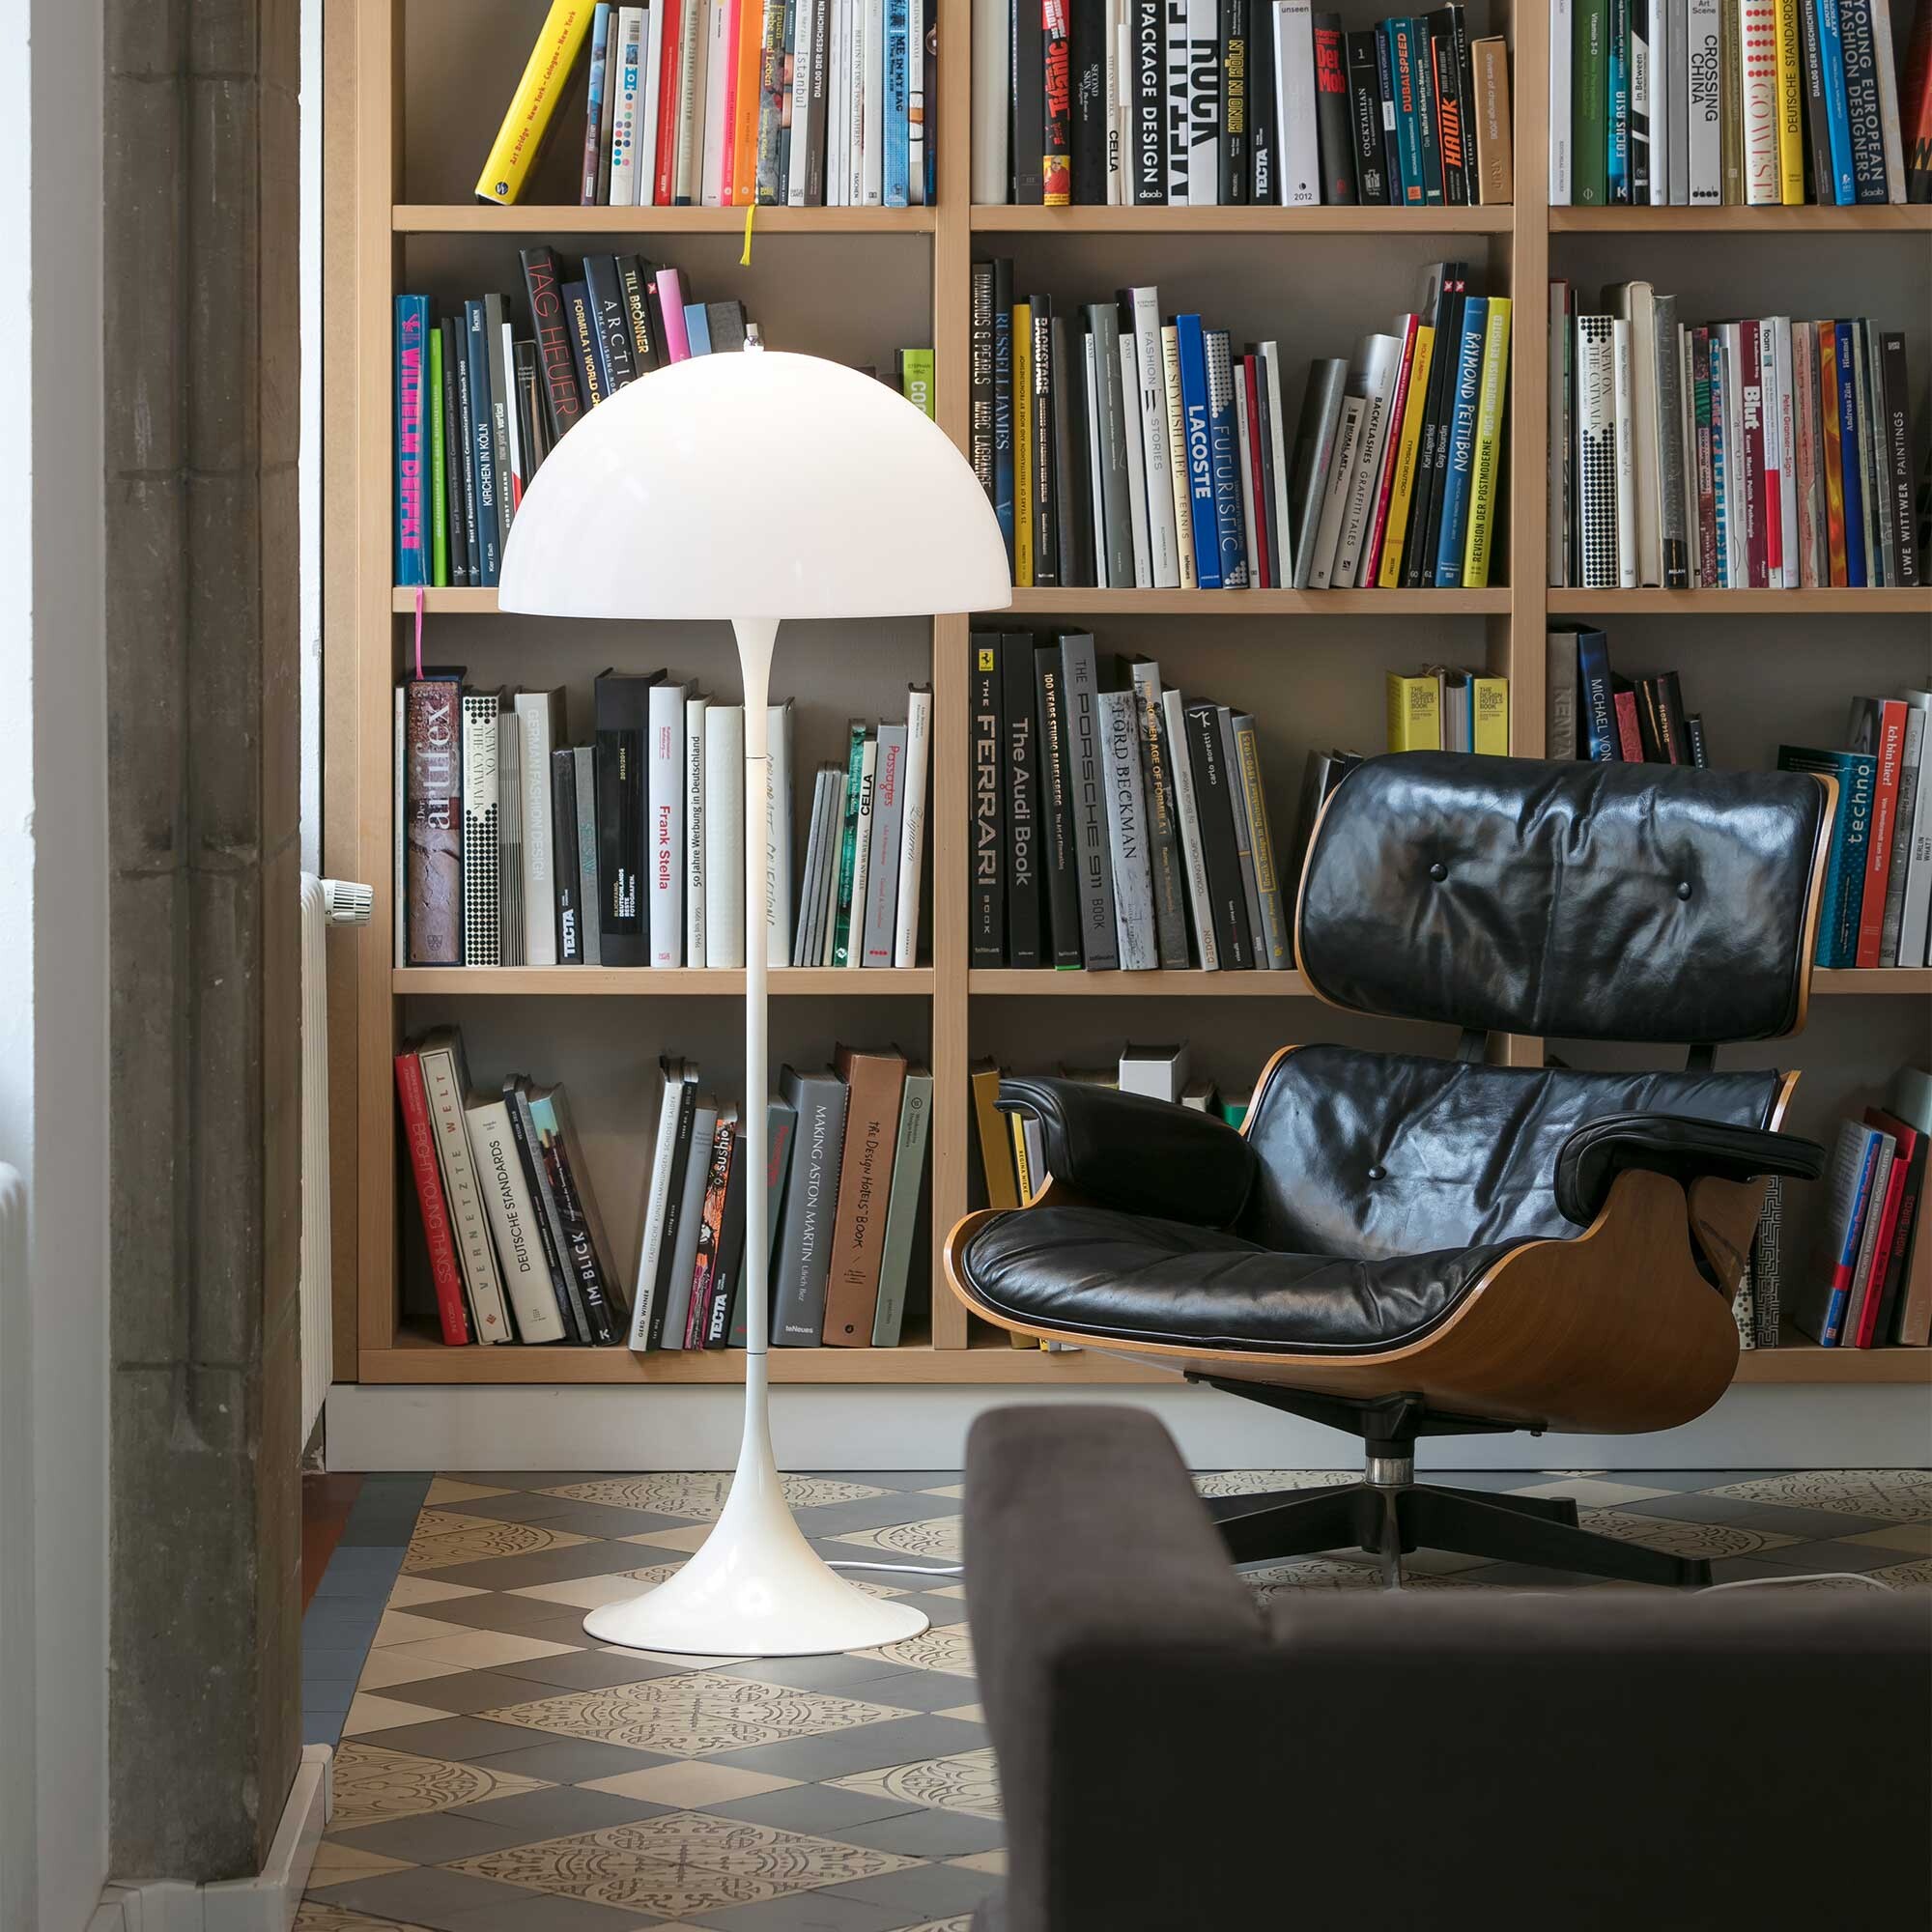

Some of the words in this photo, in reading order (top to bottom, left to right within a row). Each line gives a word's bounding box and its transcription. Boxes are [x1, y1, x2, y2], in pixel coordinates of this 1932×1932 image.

[815, 1, 825, 53] GESCHICHTEN
[1782, 0, 1796, 68] STANDARDS
[1804, 0, 1816, 52] GESCHICHTEN
[1839, 0, 1860, 78] FASHION
[1855, 0, 1872, 69] YOUNG
[814, 54, 823, 70] DER
[1141, 3, 1157, 98] PACKAGE
[1224, 40, 1244, 78] KÖLN
[1316, 43, 1339, 69] Der
[1809, 52, 1818, 69] DER
[515, 128, 529, 152] Bridge
[526, 105, 537, 121] New
[533, 87, 547, 102] York
[543, 51, 560, 80] Cologne
[556, 30, 569, 45] New
[563, 11, 577, 27] York
[795, 50, 809, 109] Istanbul
[813, 71, 822, 98] DIALOG
[1045, 41, 1069, 118] Titanic
[1083, 71, 1092, 90] SKIN
[1091, 64, 1099, 98] SECOND
[1228, 80, 1244, 96] IN
[1319, 69, 1346, 94] Mob
[1690, 52, 1705, 104] CHINA
[1704, 34, 1719, 122] CROSSING
[1810, 69, 1821, 98] DIALOG
[1228, 99, 1244, 133] KINO
[1357, 87, 1372, 157] COCKTAILIAN
[1785, 72, 1799, 133] DEUTSCHE
[1109, 130, 1119, 173] CELLA
[1142, 107, 1158, 184] DESIGN
[1441, 96, 1463, 168] HAWK
[1848, 85, 1870, 182] DESIGNERS
[1861, 78, 1884, 181] EUROPEAN
[1256, 148, 1268, 198] TECTA
[1293, 192, 1313, 202] 2012
[527, 256, 560, 318] TAG
[624, 270, 639, 294] TILL
[974, 272, 991, 327] DIAMONDS
[628, 295, 649, 355] BRÖNNER
[1763, 328, 1772, 352] foam
[540, 326, 579, 416] HEUER
[974, 344, 991, 385] PEARLS
[995, 312, 1010, 390] RUSSELL
[1035, 317, 1049, 395] BACKSTAGE
[1461, 331, 1482, 399] RAYMOND
[1589, 344, 1600, 368] THE
[1602, 346, 1611, 374] NEW
[1841, 337, 1850, 368] Himmel
[402, 347, 420, 453] WILHELM
[1144, 330, 1156, 385] FASHION
[1151, 417, 1163, 470] STORIES
[1590, 371, 1602, 431] CATWALK
[1602, 377, 1611, 395] ON
[1743, 385, 1762, 430] Blut
[1842, 382, 1852, 399] Züst
[477, 423, 490, 450] KÖLN
[974, 401, 991, 430] MARC
[995, 392, 1010, 450] JAMES
[1362, 396, 1383, 464] BACKFLASHES
[1453, 404, 1475, 472] PETTIBON
[1844, 400, 1855, 432] Andreas
[480, 451, 491, 462] IN
[975, 435, 991, 488] LAGRANGE
[1188, 405, 1211, 498] LACOSTE
[1423, 455, 1434, 469] Karl
[1424, 424, 1436, 455] Lagerfeld
[1435, 455, 1447, 469] Guy
[1436, 424, 1449, 455] Bourdin
[1893, 411, 1906, 475] PAINTINGS
[466, 456, 474, 520] Business-to-Business
[481, 463, 494, 506] KIRCHEN
[502, 470, 511, 501] HAMANN
[1211, 425, 1238, 553] FUTURISTIC
[1351, 470, 1369, 515] GRAFFITI
[469, 520, 474, 528] of
[1179, 494, 1190, 540] TENNIS
[1346, 518, 1361, 546] TALES
[1897, 483, 1912, 542] WITTWER
[1901, 547, 1913, 576] UWE
[1043, 673, 1055, 689] 100
[1075, 661, 1088, 683] THE
[1044, 691, 1057, 718] YEARS
[1590, 678, 1608, 733] MICHAEL
[1599, 734, 1612, 762] VON
[526, 709, 542, 769] GERMAN
[1011, 718, 1029, 762] The
[1046, 720, 1059, 751] STUDIO
[1111, 708, 1129, 760] FORD
[1203, 732, 1214, 762] moretti
[1885, 743, 1896, 760] bin
[1887, 725, 1898, 743] Ich
[691, 736, 700, 794] Deutschland
[879, 745, 900, 808] Passages
[1049, 753, 1063, 806] BABELSBERG
[1076, 692, 1100, 847] PORSCHE
[1208, 764, 1218, 785] carlo
[1882, 761, 1893, 786] hier!
[528, 771, 545, 830] FASHION
[692, 796, 699, 805] in
[861, 774, 873, 816] CELLA
[977, 714, 997, 885] FERRARI
[1012, 766, 1031, 819] Audi
[1116, 766, 1137, 860] BECKMAN
[1847, 764, 1870, 844] techno
[659, 805, 670, 846] Frank
[692, 807, 702, 848] Werbung
[531, 831, 545, 881] DESIGN
[659, 849, 670, 890] Stella
[692, 849, 701, 873] Jahre
[1014, 826, 1032, 886] Book
[1088, 855, 1103, 889] 911
[1916, 837, 1925, 862] BERLIN
[693, 875, 701, 887] 50
[562, 908, 576, 958] TECTA
[982, 895, 991, 934] BOOK
[1092, 898, 1105, 929] BOOK
[1204, 929, 1215, 964] DEDON
[412, 1122, 432, 1175] BRIGHT
[810, 1104, 828, 1159] MAKING
[488, 1141, 516, 1210] STANDARDS
[806, 1162, 822, 1208] ASTON
[421, 1176, 443, 1229] YOUNG
[1901, 1195, 1915, 1225] BIRDS
[431, 1227, 452, 1283] THINGS
[505, 1212, 531, 1274] DEUTSCHE
[570, 1231, 595, 1280] BLICK
[801, 1210, 817, 1262] MARTIN
[1894, 1227, 1909, 1257] NIGHT
[584, 1286, 603, 1307] IM
[798, 1288, 808, 1302] Bez
[800, 1264, 810, 1287] Ulrich
[708, 1293, 727, 1342] TECTA
